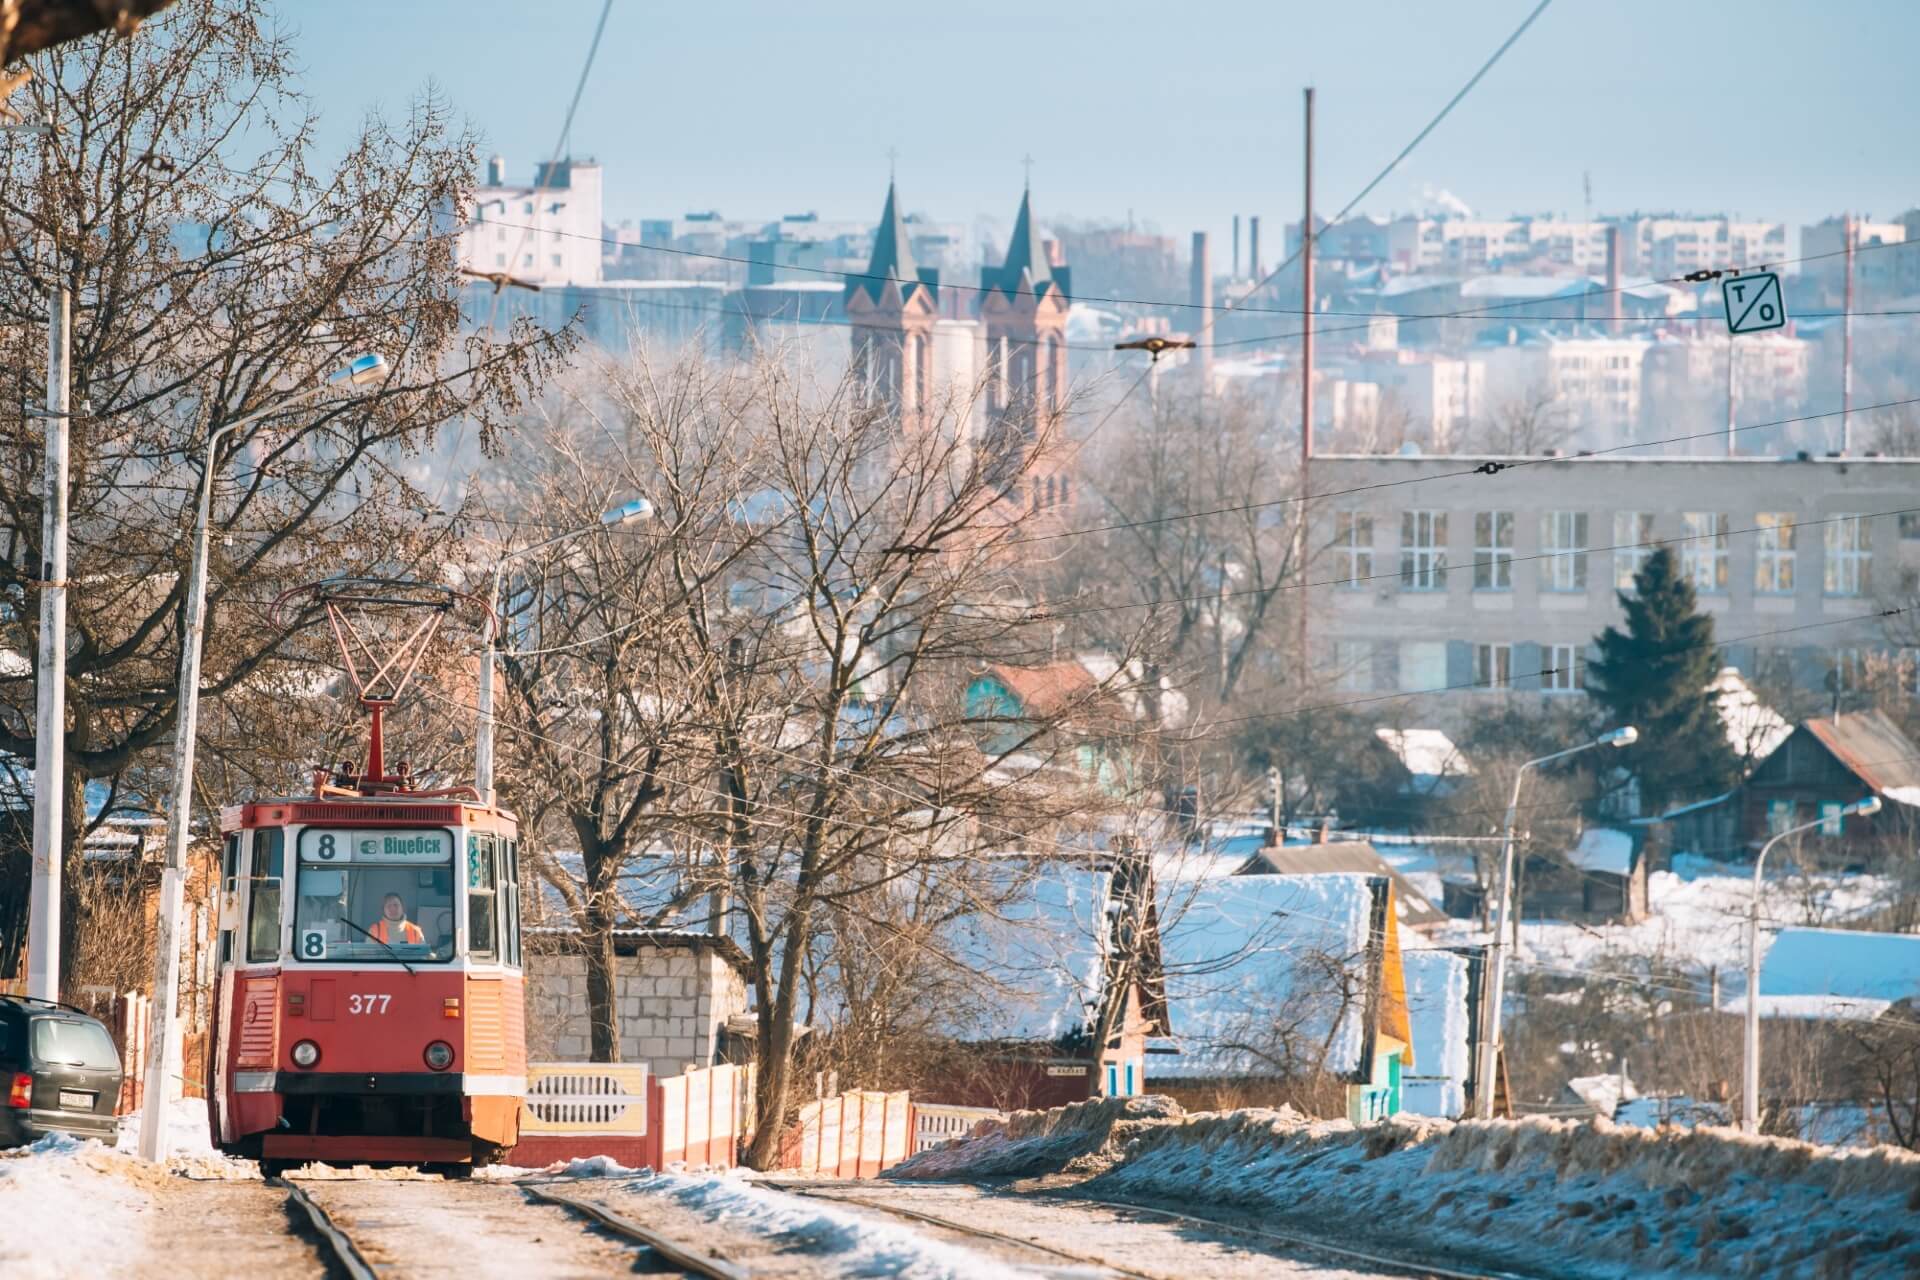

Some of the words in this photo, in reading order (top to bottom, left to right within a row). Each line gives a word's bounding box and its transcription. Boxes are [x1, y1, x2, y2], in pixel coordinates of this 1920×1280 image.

[318, 834, 336, 860] 8
[384, 836, 441, 856] Віцебск
[304, 932, 324, 957] 8
[349, 994, 392, 1014] 377
